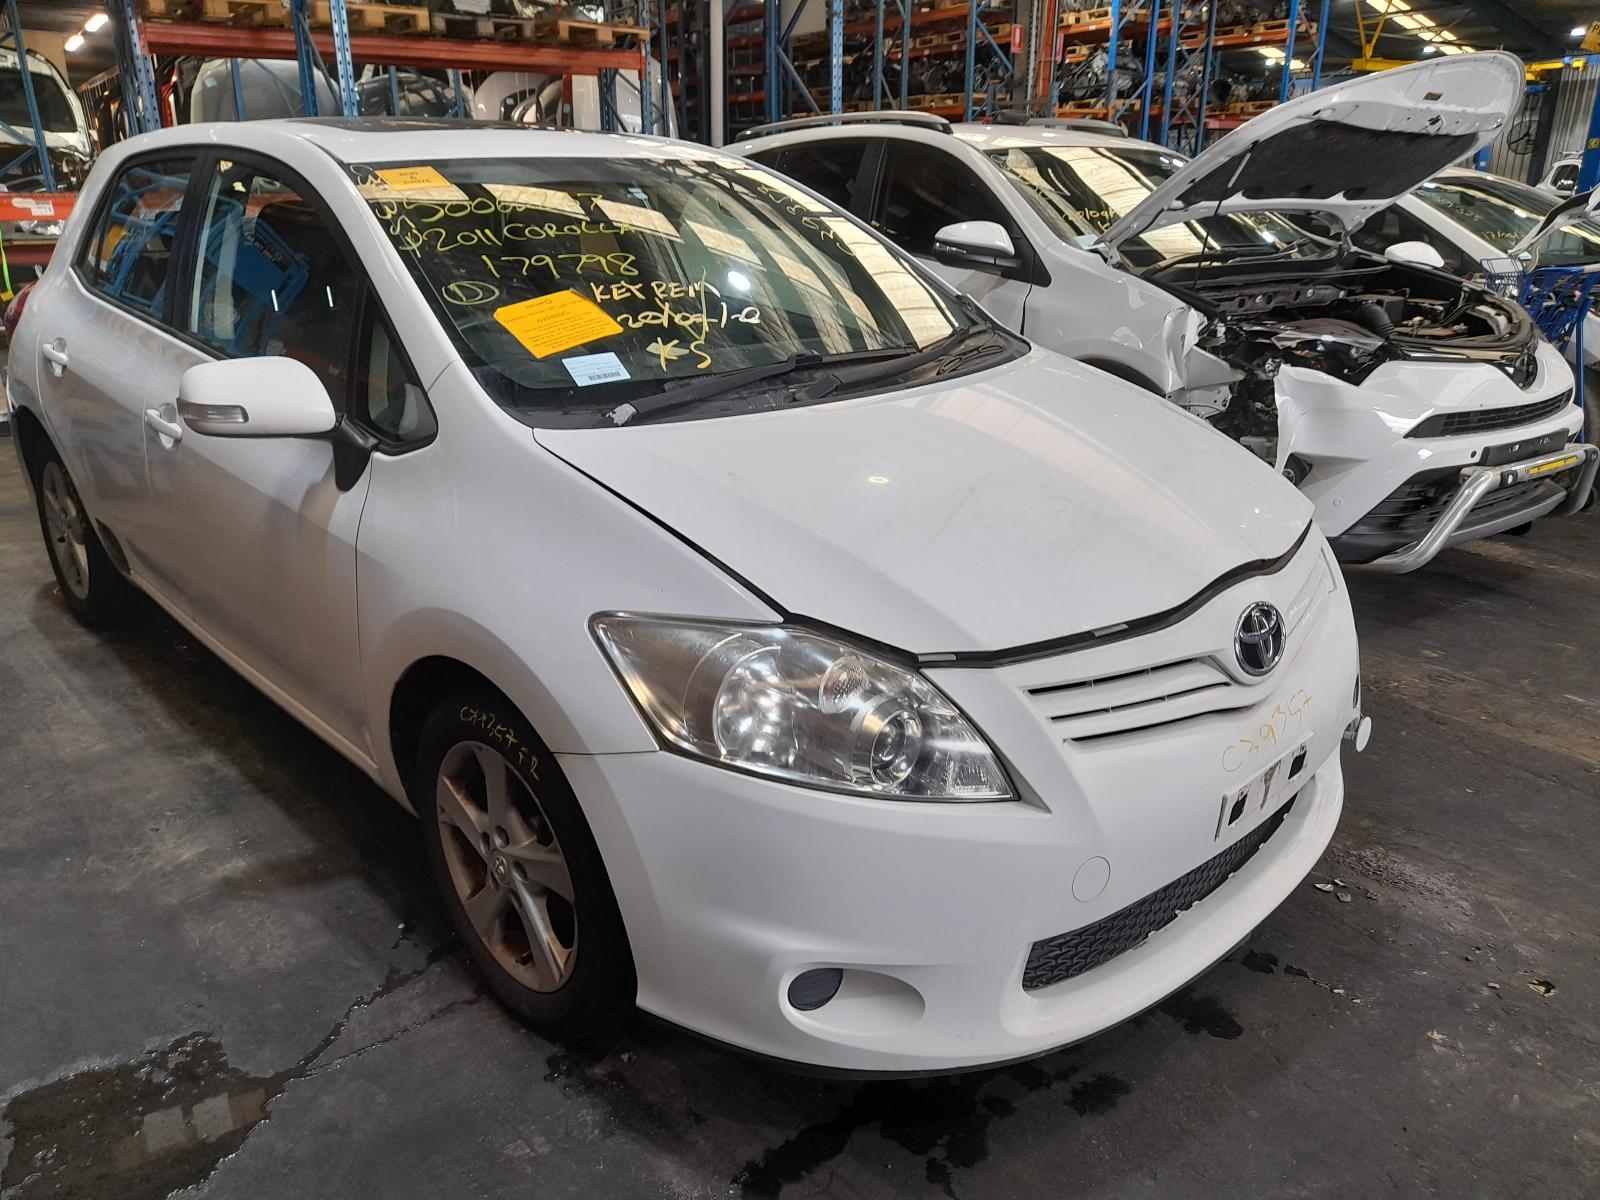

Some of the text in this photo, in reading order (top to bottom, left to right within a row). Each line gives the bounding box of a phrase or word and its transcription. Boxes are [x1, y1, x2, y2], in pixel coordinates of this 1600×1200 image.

[424, 221, 637, 252] 2011 COROLLA
[481, 253, 639, 279] 179798
